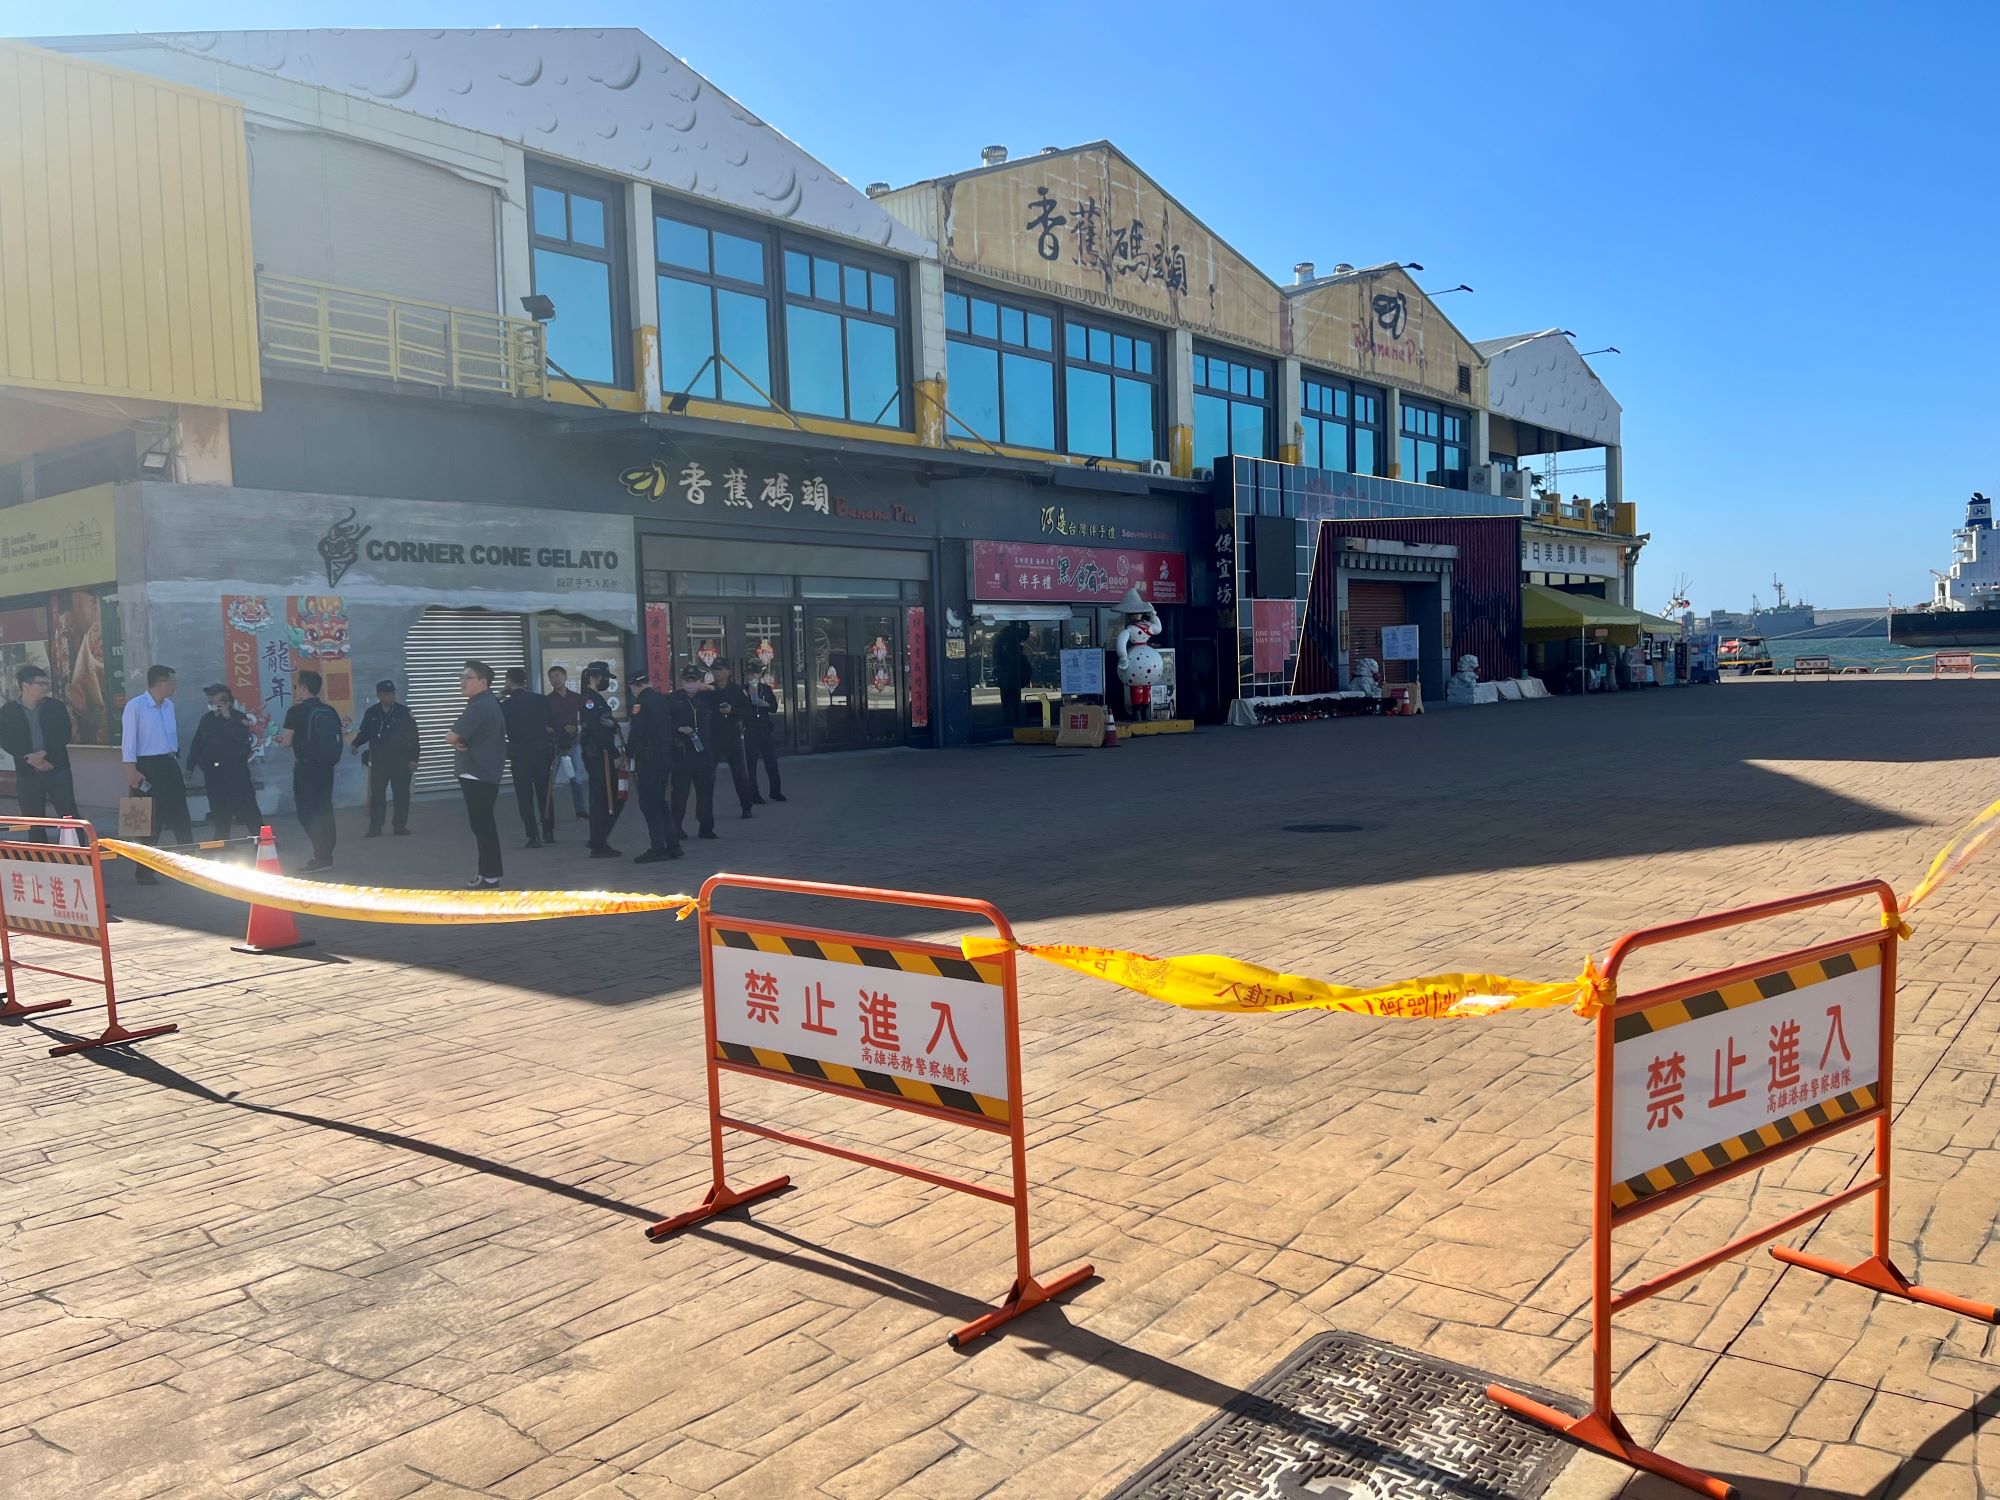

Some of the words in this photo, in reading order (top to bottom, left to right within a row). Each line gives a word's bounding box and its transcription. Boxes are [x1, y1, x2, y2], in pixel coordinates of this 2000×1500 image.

[1026, 187, 1188, 296] 香蕉碼頭
[679, 462, 830, 515] 香蕉碼頭
[366, 540, 465, 565] CORNER
[470, 545, 532, 567] CONE
[537, 548, 619, 570] GELATO
[1215, 533, 1233, 604] 便宜坊
[1018, 573, 1053, 590] 伴手禮
[232, 641, 253, 688] 2024
[261, 640, 298, 708] 龍年
[10, 870, 89, 911] 禁止進入
[744, 968, 969, 1063] 禁止進入
[861, 1047, 971, 1086] 高雄港務警察總隊
[1646, 1004, 1851, 1131] 禁止進入
[1766, 1067, 1853, 1115] 高雄港務警察總隊
